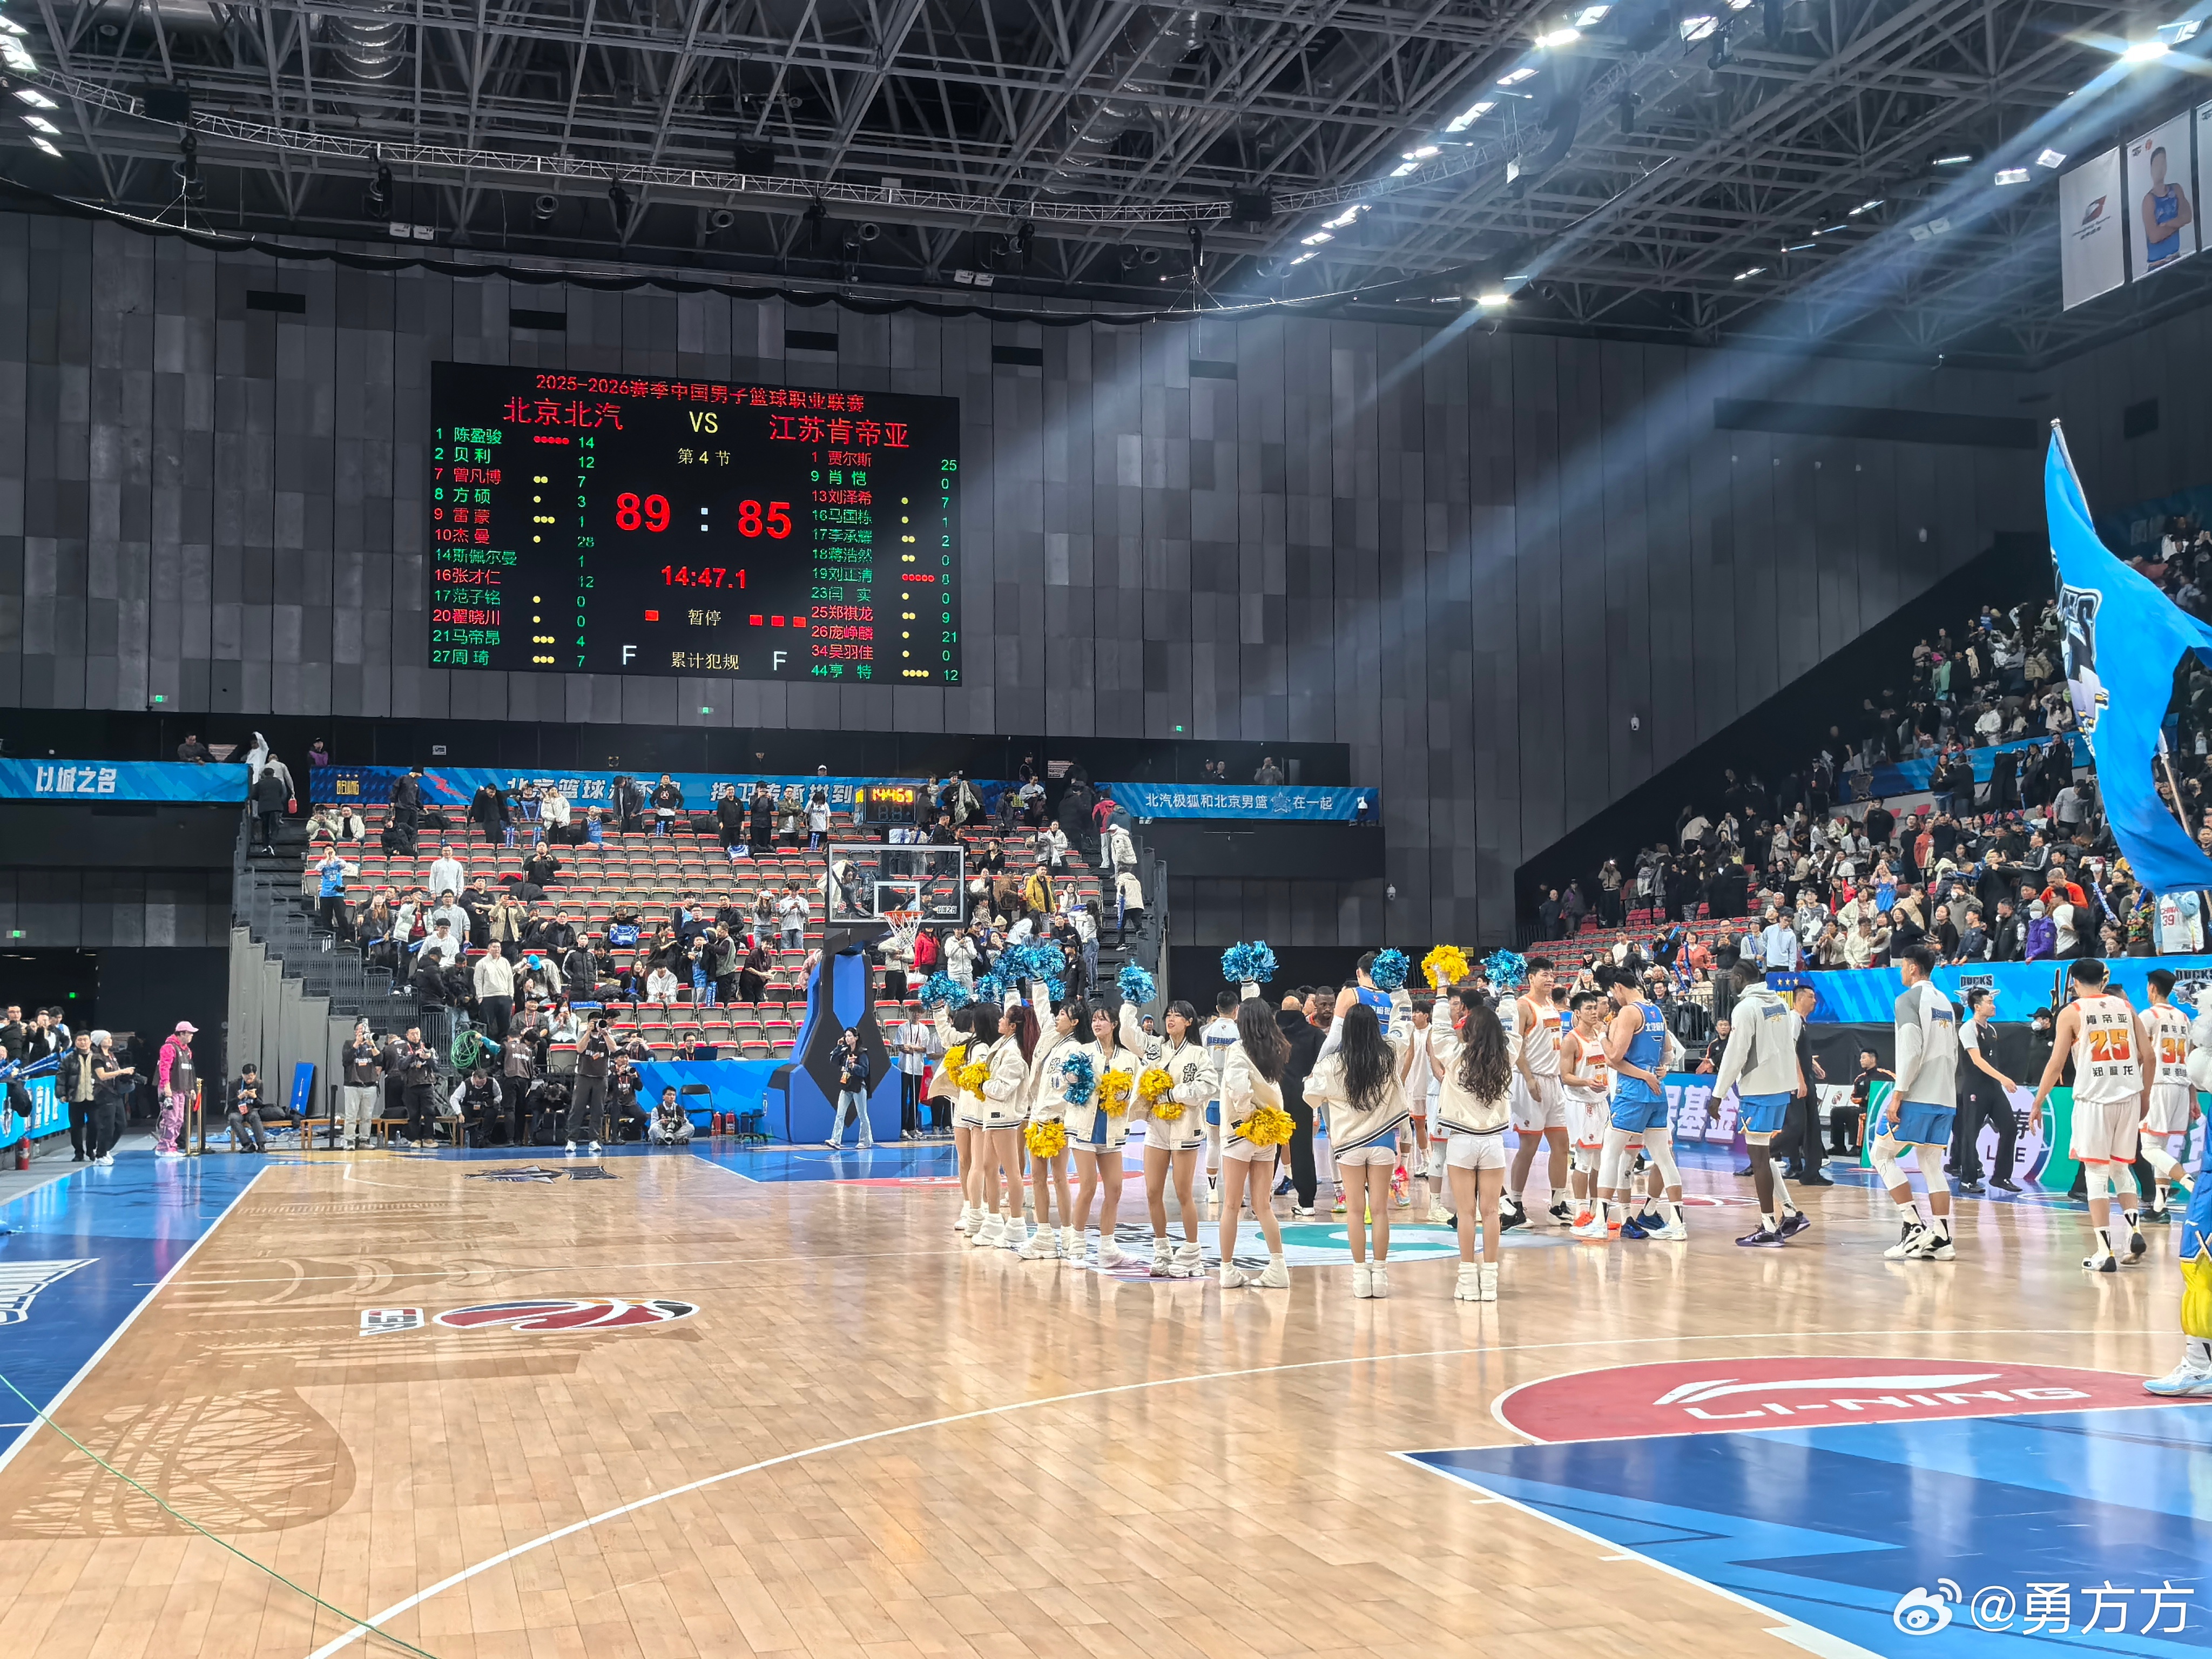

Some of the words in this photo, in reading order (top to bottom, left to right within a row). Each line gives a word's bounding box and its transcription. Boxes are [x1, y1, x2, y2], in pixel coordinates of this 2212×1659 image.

[536, 375, 865, 412] 2025-2026赛季中国男子篮球职业联赛
[503, 396, 623, 430] 北京北汽
[689, 411, 718, 433] VS
[455, 427, 502, 445] 陈盈骏
[579, 437, 595, 449] 14
[770, 414, 909, 448] 江苏肯帝亚
[435, 448, 444, 460] 2
[579, 457, 595, 469] 12
[829, 451, 872, 468] 贾尔斯
[942, 460, 957, 472] 25
[435, 468, 444, 480] 7
[454, 468, 502, 485] 曾凡博
[578, 476, 586, 488] 7
[811, 471, 820, 482] 9
[942, 478, 949, 490] 0
[435, 488, 444, 501] 8
[578, 496, 586, 508] 3
[813, 490, 827, 502] 13
[942, 497, 949, 509] 7
[435, 508, 443, 521] 9
[616, 493, 670, 532] 89
[738, 500, 792, 539] 85
[813, 510, 828, 522] 16
[436, 529, 452, 541] 10
[578, 537, 595, 548] 28
[812, 529, 828, 541] 17
[942, 535, 950, 548] 2
[437, 549, 451, 561] 14
[813, 550, 828, 560] 18
[942, 555, 950, 567] 0
[435, 569, 451, 582] 16
[453, 568, 501, 585] 张才仁
[579, 576, 594, 588] 12
[662, 565, 745, 589] 14:47.1
[813, 568, 828, 579] 19
[942, 574, 950, 585] 8
[435, 590, 451, 602] 17
[577, 596, 586, 608] 0
[812, 587, 828, 599] 23
[942, 593, 950, 605] 0
[433, 609, 451, 623] 20
[577, 616, 586, 628] 0
[689, 609, 721, 626] 暂停
[812, 606, 829, 619] 25
[828, 605, 874, 622] 郑祺龙
[942, 612, 950, 624] 9
[434, 630, 449, 642] 21
[453, 629, 501, 646] 马帝昂
[577, 636, 586, 648] 4
[812, 625, 829, 638] 26
[942, 631, 957, 644] 21
[434, 650, 451, 663] 27
[577, 656, 585, 668] 7
[622, 645, 637, 665] F
[671, 652, 739, 670] 累计犯规
[773, 651, 787, 671] F
[812, 645, 829, 657] 34
[828, 644, 874, 660] 吴羽佳
[942, 650, 950, 662] 0
[811, 665, 828, 677] 44
[944, 670, 959, 681] 12
[36, 766, 117, 793] 以城之名
[1145, 793, 1268, 810] 北汽极狐和北京男篮
[2162, 914, 2175, 927] 39
[1960, 974, 1994, 988] DUCKS
[2088, 1028, 2130, 1062] 25
[1683, 1387, 2093, 1419] LI-NING
